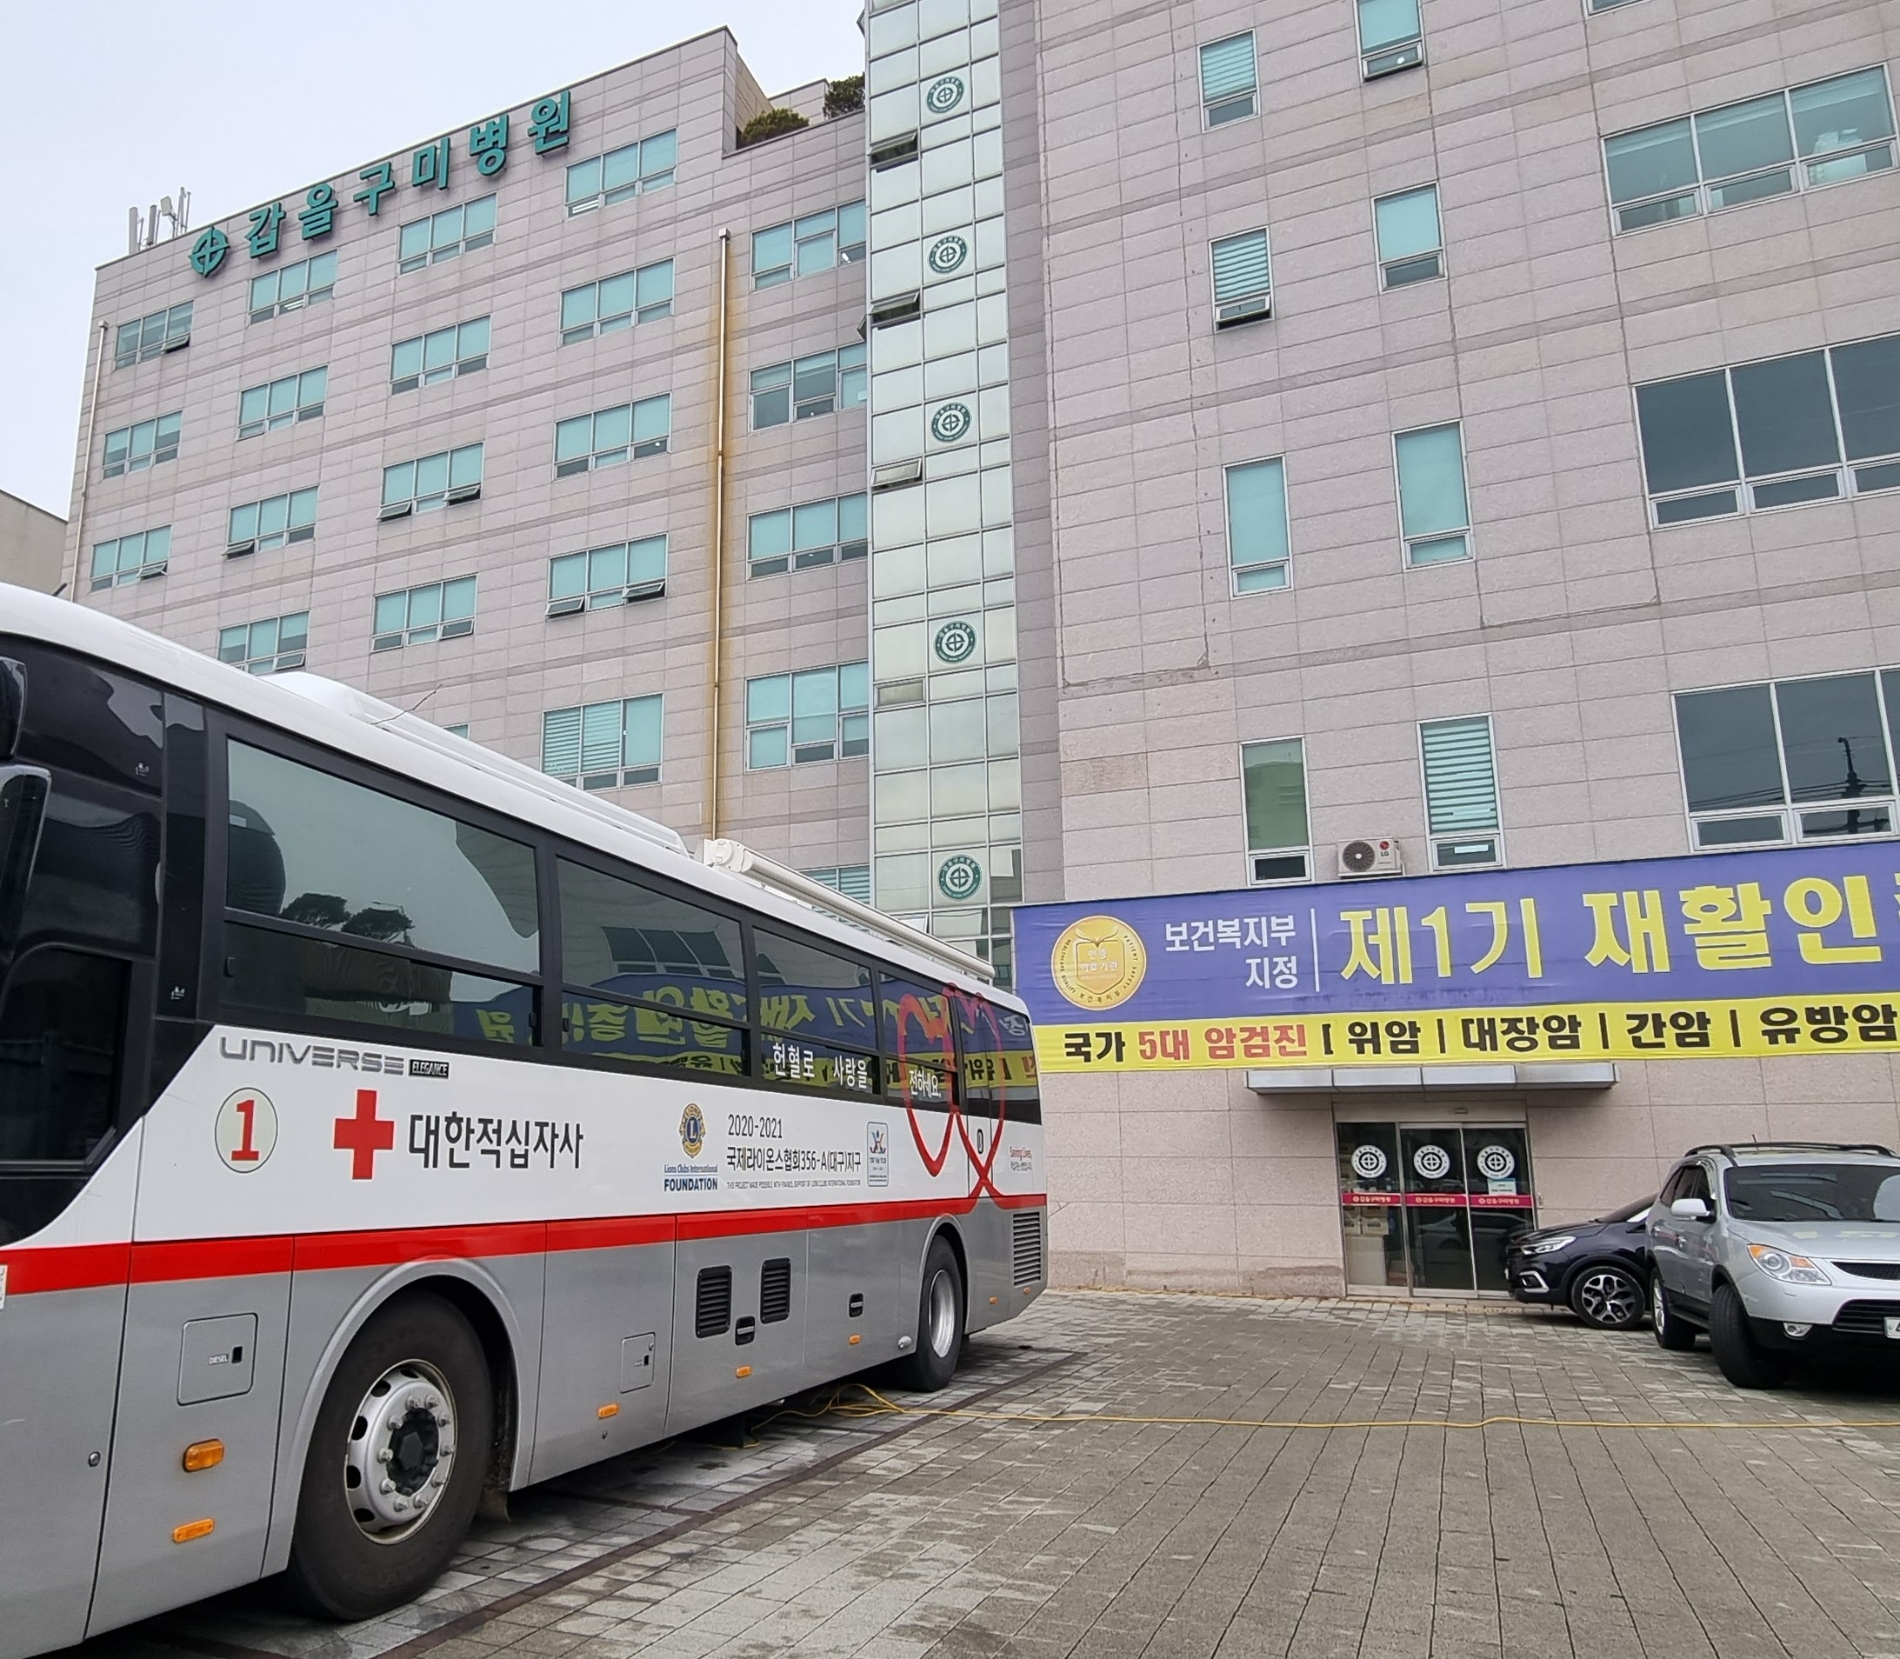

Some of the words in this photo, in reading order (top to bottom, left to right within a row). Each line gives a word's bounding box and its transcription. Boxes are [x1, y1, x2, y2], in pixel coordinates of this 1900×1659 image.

[244, 89, 571, 260] 갑을구미병원
[1380, 850, 1390, 858] LG
[1165, 915, 1298, 953] 보건복지부
[1339, 897, 1543, 985] 제1기
[1583, 870, 1900, 976] 재활인
[1245, 956, 1298, 990] 지정
[1064, 1031, 1126, 1064] 국가
[1139, 1029, 1192, 1062] 5대
[1203, 1023, 1308, 1061] 암검진
[1347, 1018, 1422, 1056] 위암
[1461, 1014, 1582, 1054] 대장암
[1626, 1009, 1712, 1050] 간암
[1759, 1003, 1899, 1046] 유방암
[219, 1036, 405, 1076] UNIVERSE
[411, 1060, 448, 1078] ELEGANCE
[772, 1042, 816, 1080] 헌혈로
[833, 1055, 869, 1090] 사랑을
[231, 1099, 260, 1162] 1
[409, 1111, 584, 1169] 대한적십자사
[727, 1113, 783, 1139] 2020-2021
[663, 1177, 718, 1192] FOUNDATION
